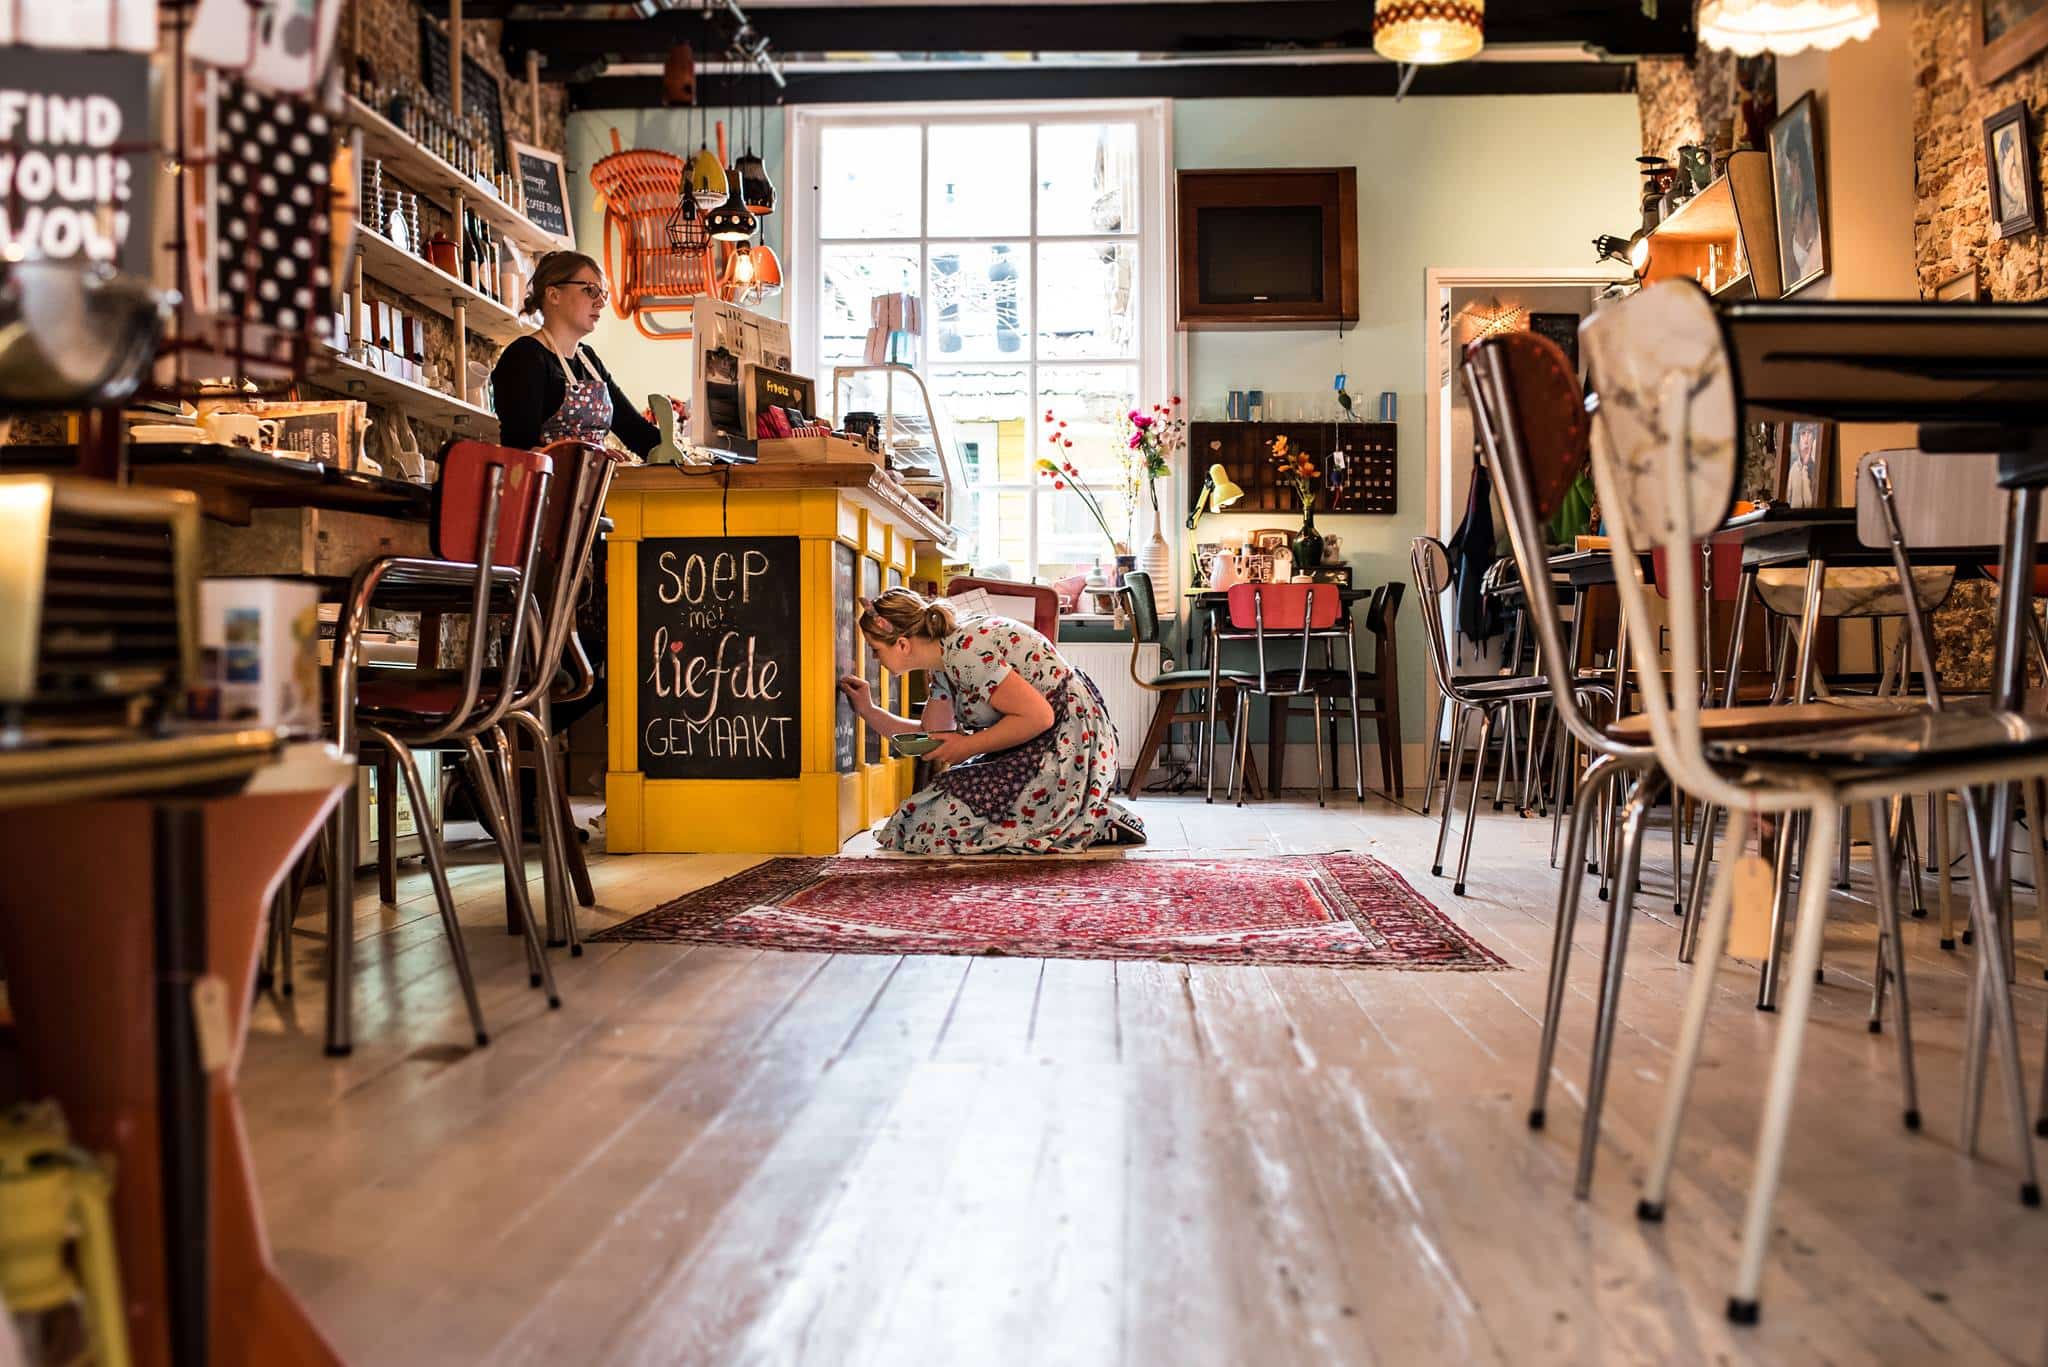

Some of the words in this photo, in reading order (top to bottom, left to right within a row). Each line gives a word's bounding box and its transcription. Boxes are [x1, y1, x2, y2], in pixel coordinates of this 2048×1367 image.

[0, 90, 122, 147] FIND
[647, 626, 782, 724] liefde
[645, 715, 792, 759] GEMAAKT
